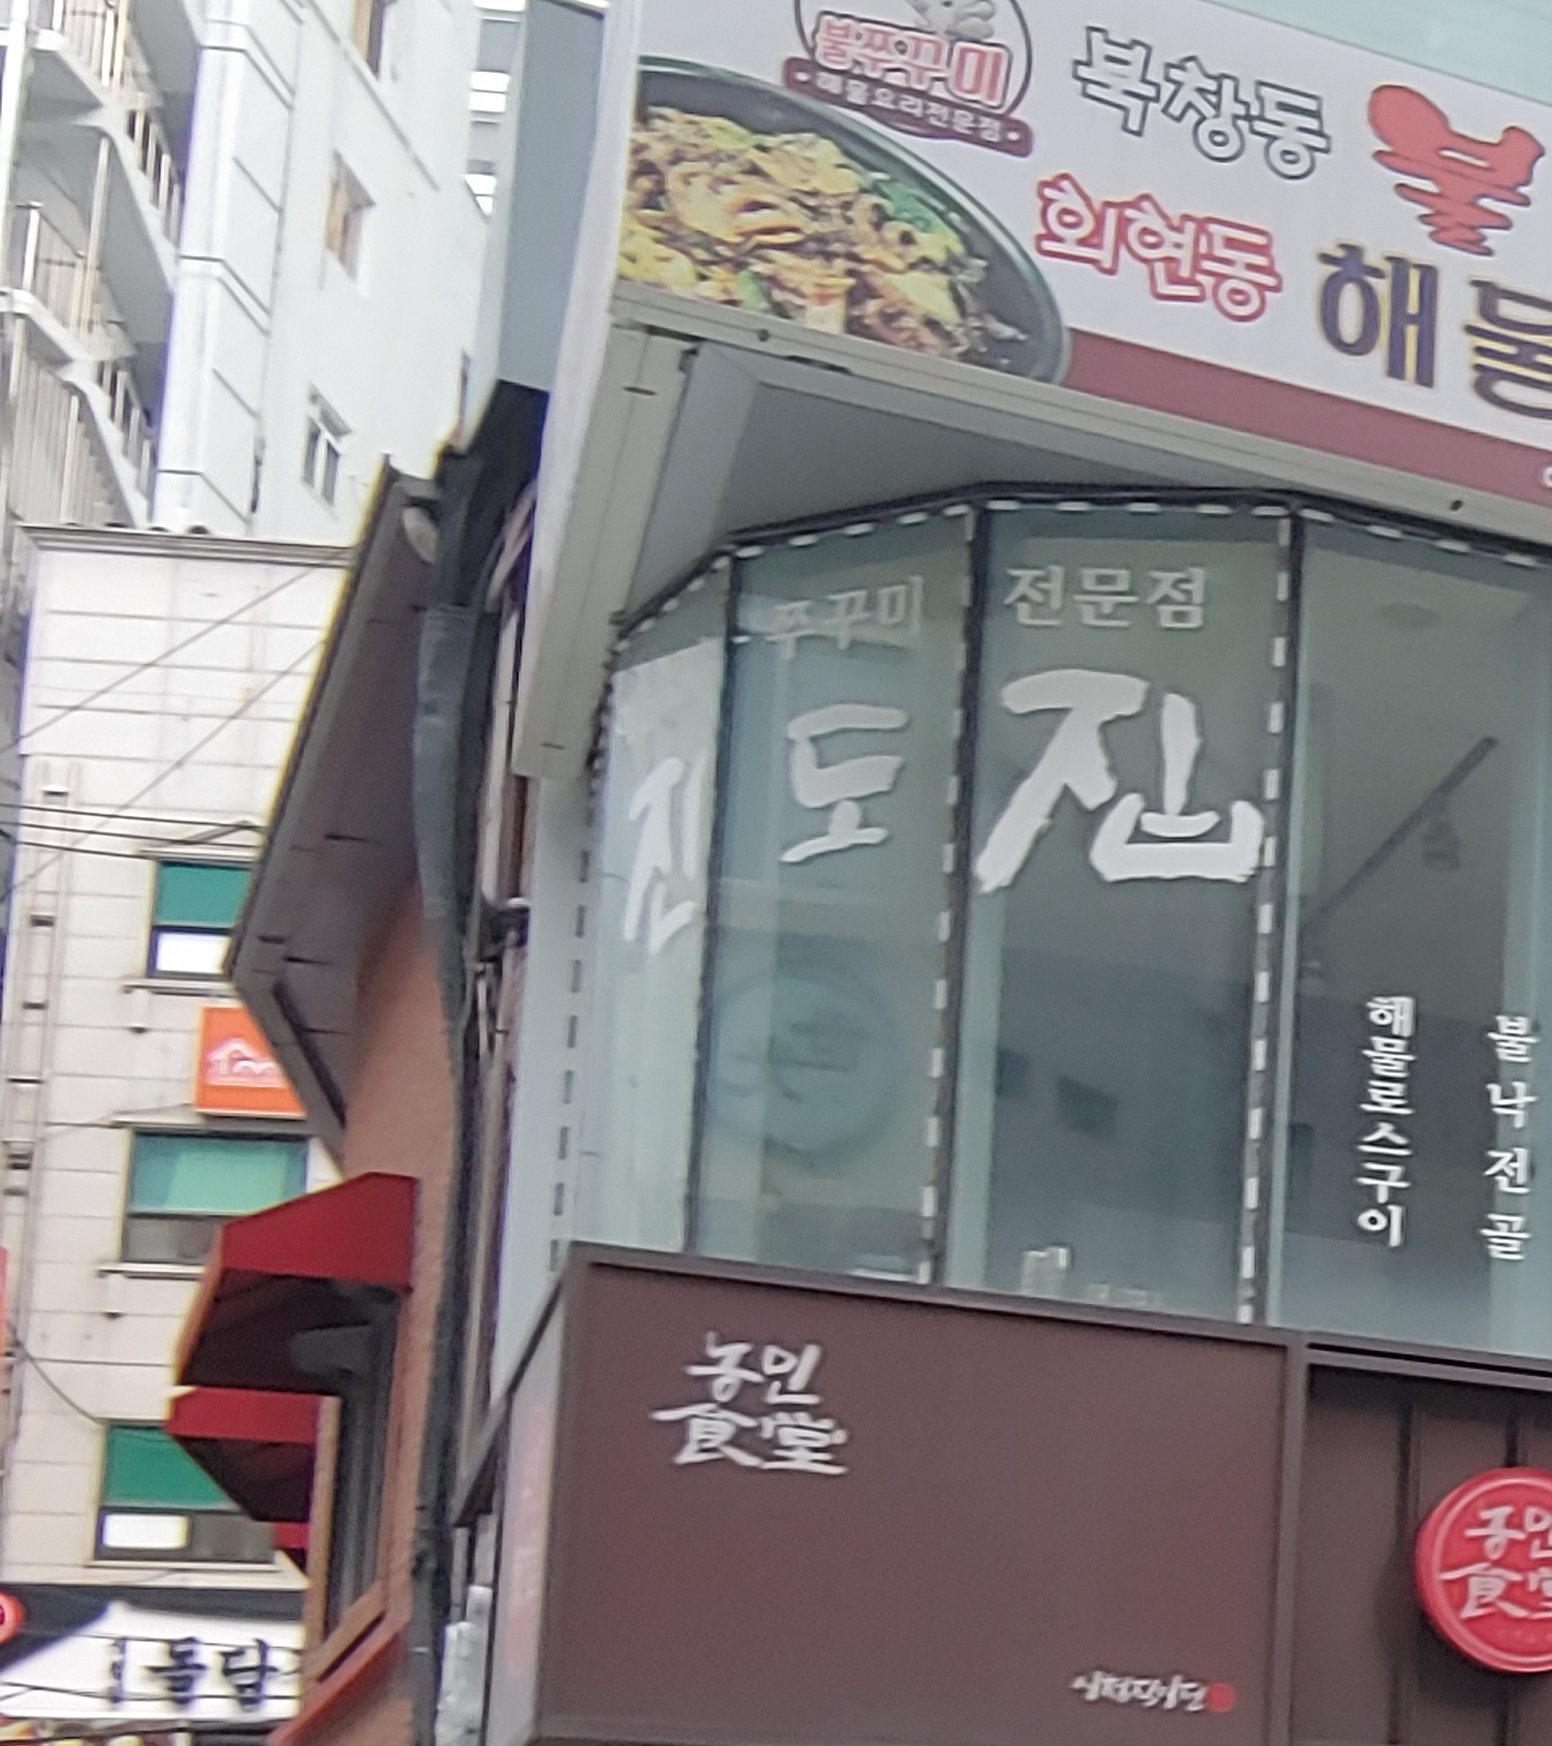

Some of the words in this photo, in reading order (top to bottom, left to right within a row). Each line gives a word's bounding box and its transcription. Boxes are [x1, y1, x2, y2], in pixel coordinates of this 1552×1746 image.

[1072, 25, 1331, 180] 북창동
[1036, 173, 1282, 322] 회현동
[1003, 565, 1207, 630] 전문점
[1357, 995, 1418, 1248] 해물로스구이
[1480, 1014, 1540, 1262] 불낙전골
[650, 1402, 849, 1475] 食堂
